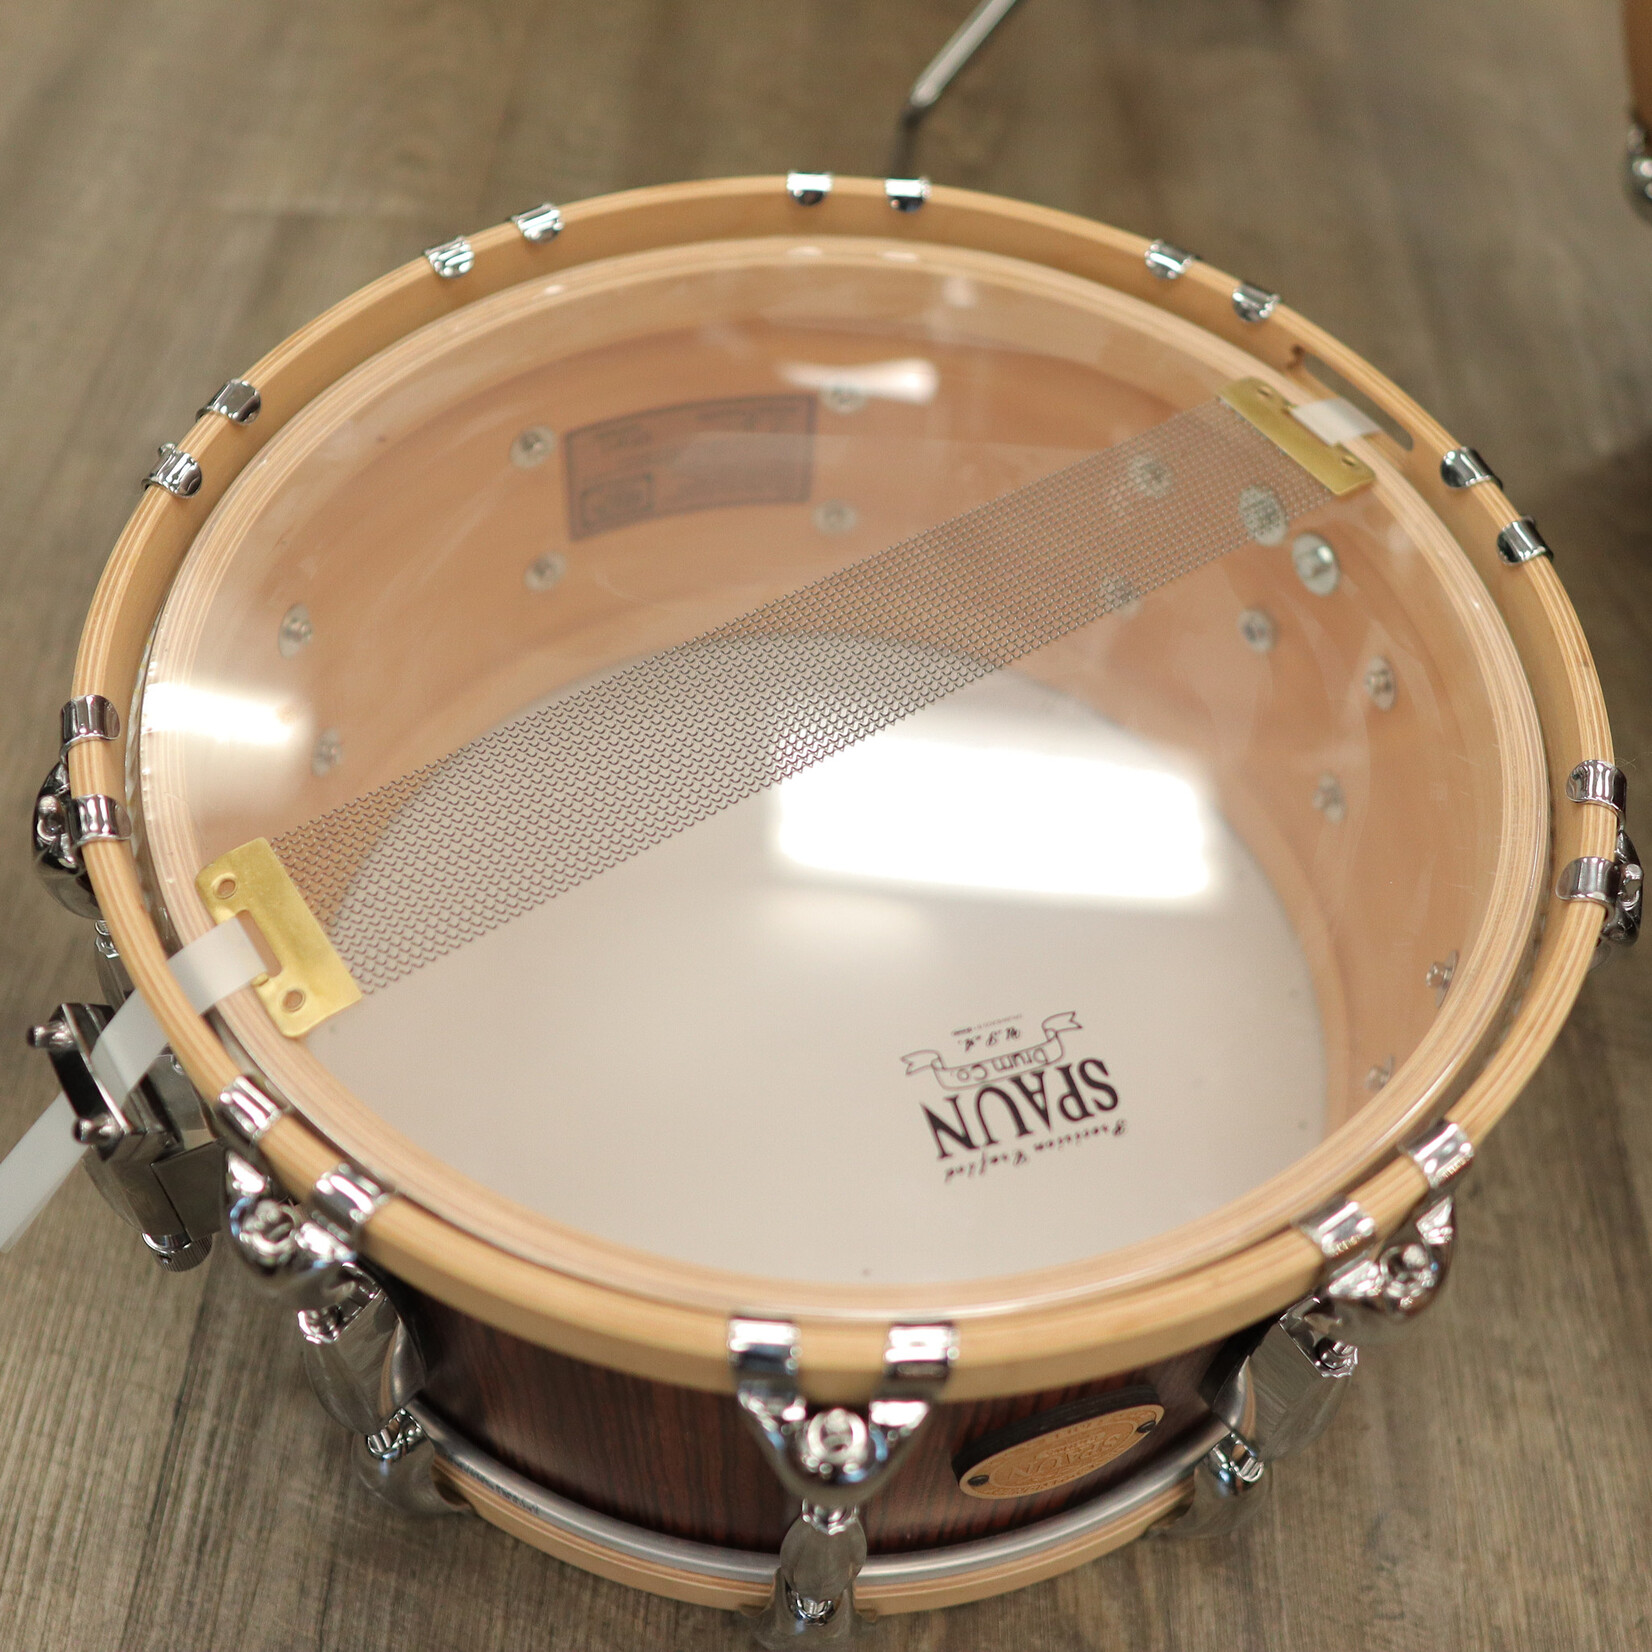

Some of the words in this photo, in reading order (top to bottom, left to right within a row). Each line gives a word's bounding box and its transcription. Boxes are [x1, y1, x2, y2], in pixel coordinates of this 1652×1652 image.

[991, 1046, 1050, 1072] Drum
[920, 1058, 1119, 1159] SPAUN
[1033, 1119, 1126, 1151] Precision
[944, 1151, 1028, 1183] Crafted
[1007, 1432, 1123, 1480] SPAUN
